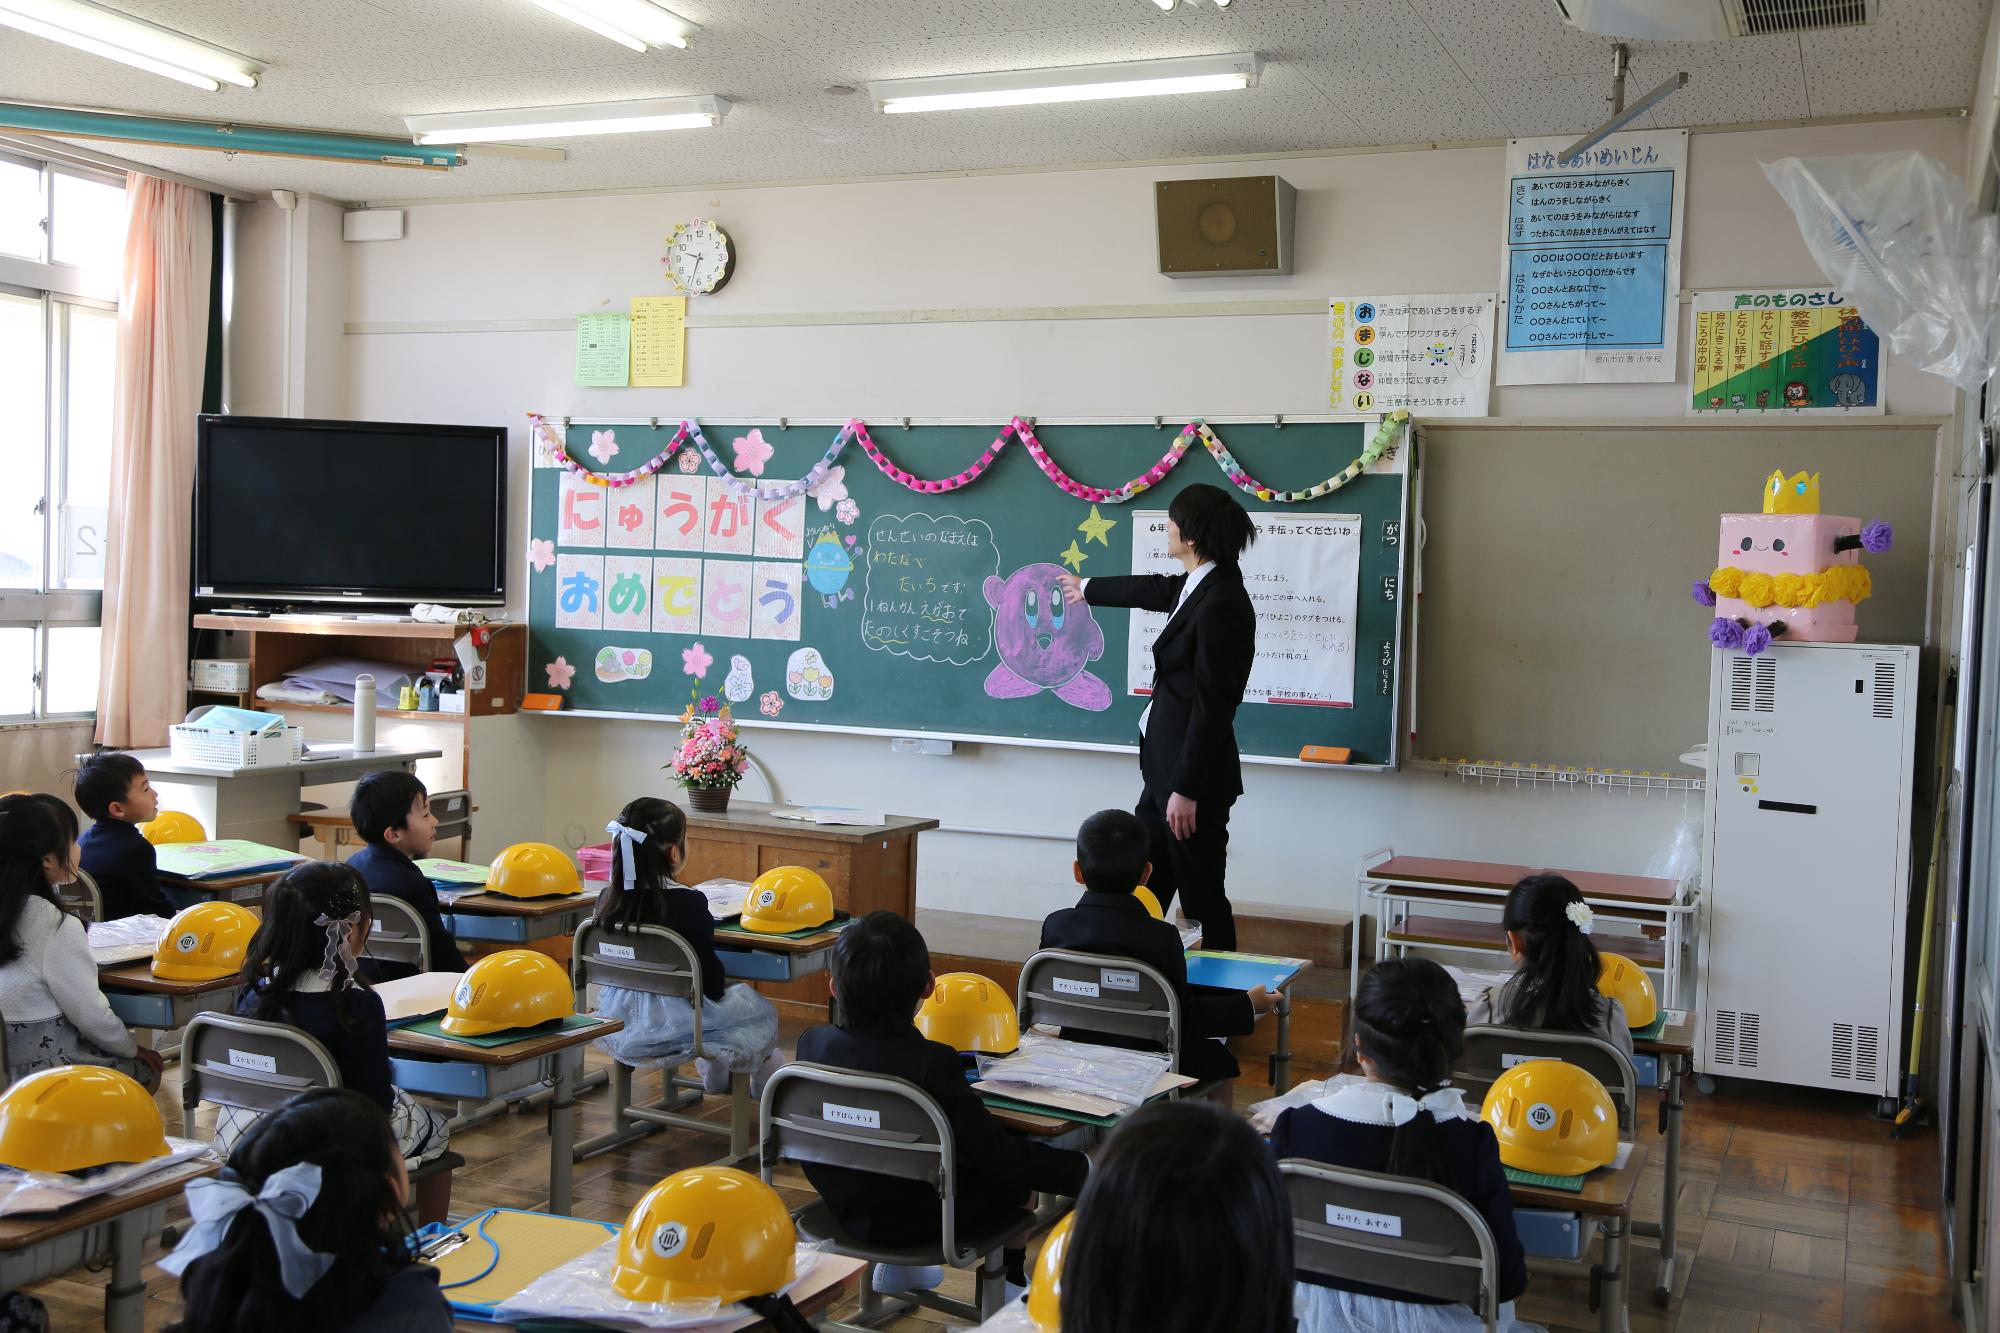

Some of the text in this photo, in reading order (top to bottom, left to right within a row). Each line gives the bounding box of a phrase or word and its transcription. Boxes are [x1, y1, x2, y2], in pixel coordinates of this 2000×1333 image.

[1532, 179, 1630, 190] あいてのほうをみながらきく
[1531, 195, 1612, 206] はんのうをしながらきく
[1531, 210, 1640, 222] あいてのほうをみながらはなす
[1514, 274, 1526, 324] はなしかた
[1734, 292, 1844, 309] 声のものさし
[1360, 306, 1372, 318] お
[1379, 307, 1482, 316] 大きな声であいさつをする子
[1359, 329, 1457, 342] ま 学んでワクワクする子
[1697, 312, 1709, 373] こころの中の声
[1713, 312, 1726, 372] 自分にきこえる声
[1734, 311, 1748, 372] となりに話す声
[1360, 352, 1370, 364] じ
[1358, 374, 1370, 386] な
[1358, 395, 1370, 408] い
[564, 488, 797, 541] にゅうがく
[1150, 523, 1168, 533] 6年
[1268, 525, 1351, 536] 手伝ってくださいね
[1386, 524, 1399, 545] がつ
[875, 530, 979, 547] せんせいのなまえは
[873, 549, 925, 568] わたなべ
[1385, 577, 1396, 600] にち
[560, 570, 795, 624] おめでとう
[1248, 593, 1326, 604] あるかごの中へ入れる。
[1382, 640, 1391, 666] ようび
[1337, 1213, 1391, 1229] おりた あすか
